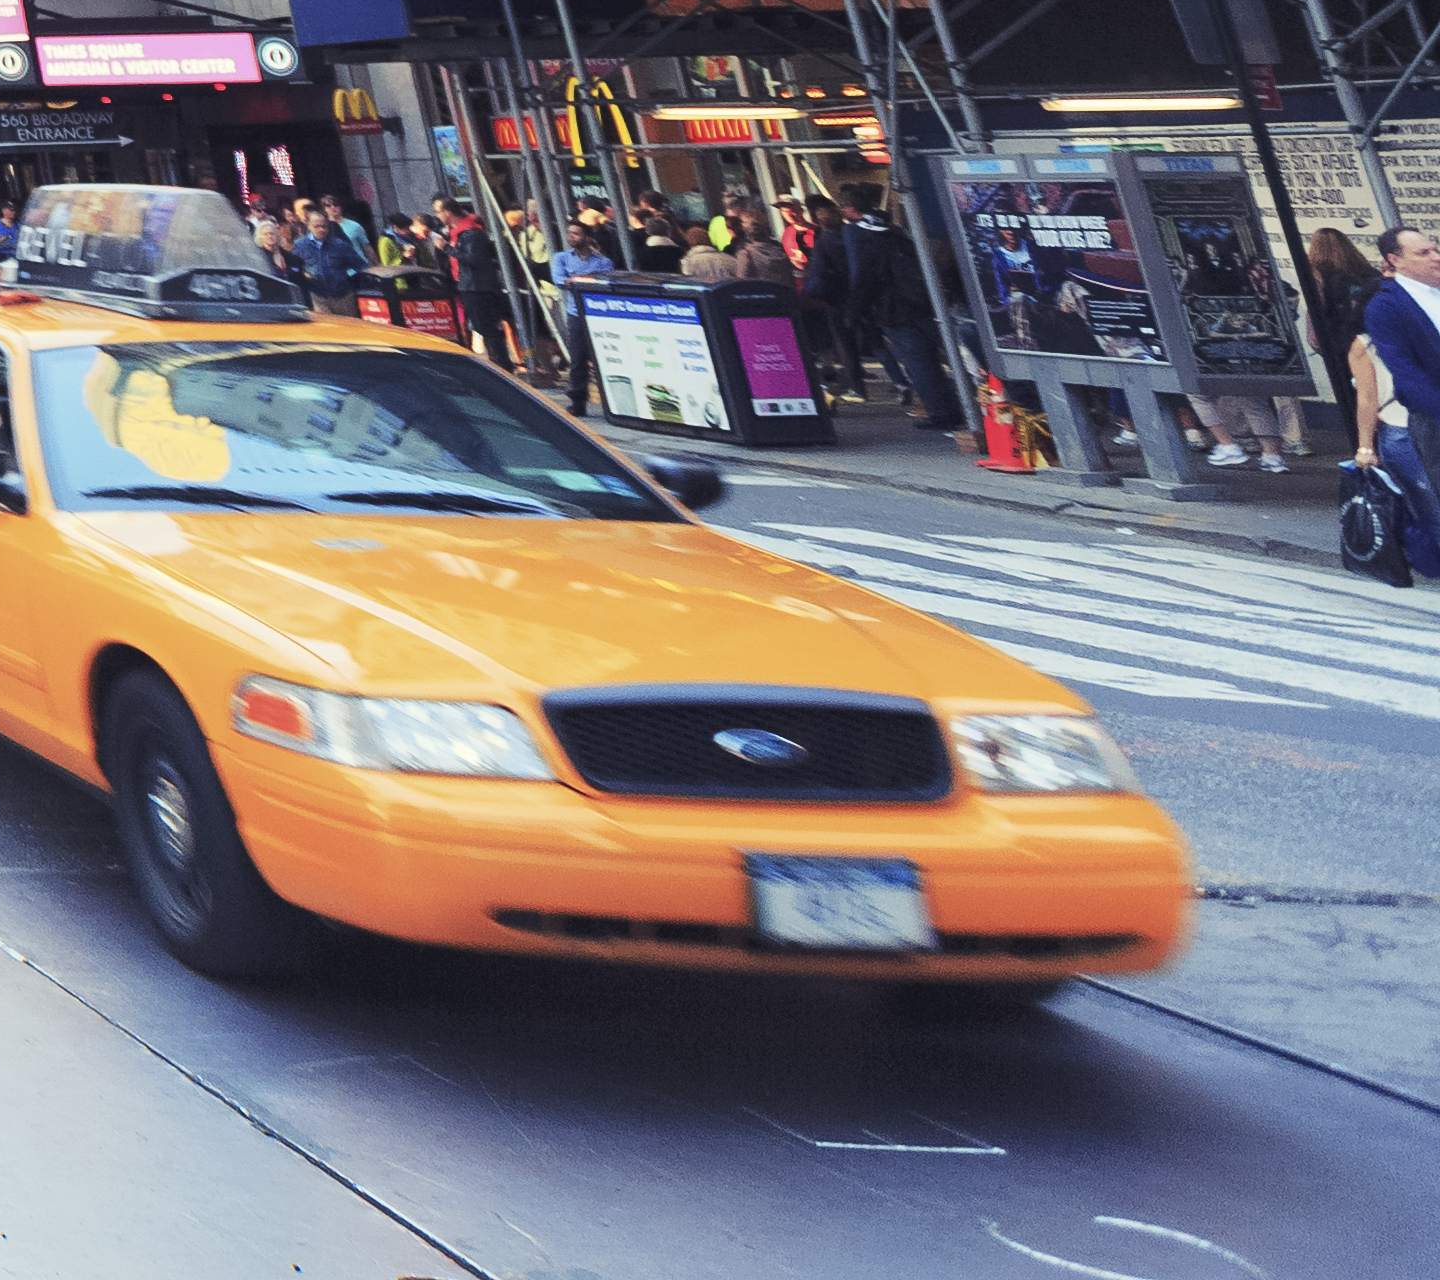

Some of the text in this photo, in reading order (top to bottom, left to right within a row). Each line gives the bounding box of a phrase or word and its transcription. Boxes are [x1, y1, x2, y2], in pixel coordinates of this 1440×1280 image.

[43, 43, 143, 58] TIMES SQUARE
[47, 60, 236, 76] MUSEUM VISITOR CENTER
